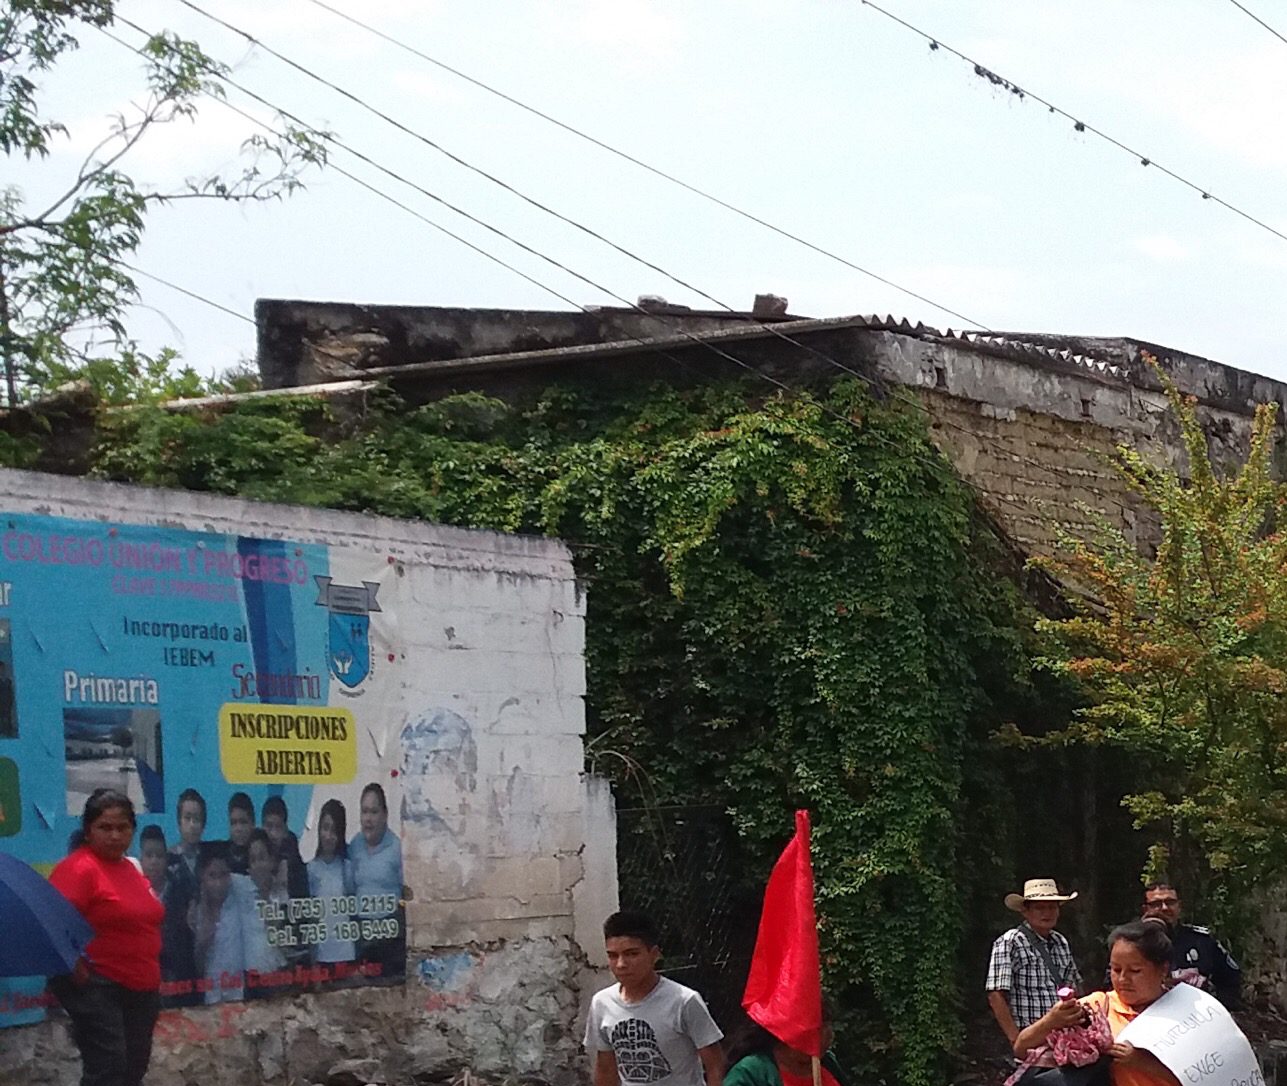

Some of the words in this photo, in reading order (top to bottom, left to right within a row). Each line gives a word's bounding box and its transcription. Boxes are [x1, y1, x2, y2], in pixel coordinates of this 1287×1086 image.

[3, 531, 103, 567] COLEGIO
[204, 550, 309, 586] PROGRESO
[123, 616, 230, 643] Incorporado
[232, 624, 248, 643] al
[164, 648, 215, 667] IEBEM
[64, 670, 158, 704] Primaria
[229, 713, 348, 741] INSCRIPCIONES
[255, 750, 333, 775] ABIERTAS
[257, 898, 286, 921] Tel.
[287, 897, 326, 923] (735)
[331, 896, 356, 916] 308
[361, 894, 397, 914] 2115
[266, 926, 298, 948] Cel.
[299, 924, 327, 945] 735
[334, 921, 360, 942] 168
[362, 918, 400, 940] 5449
